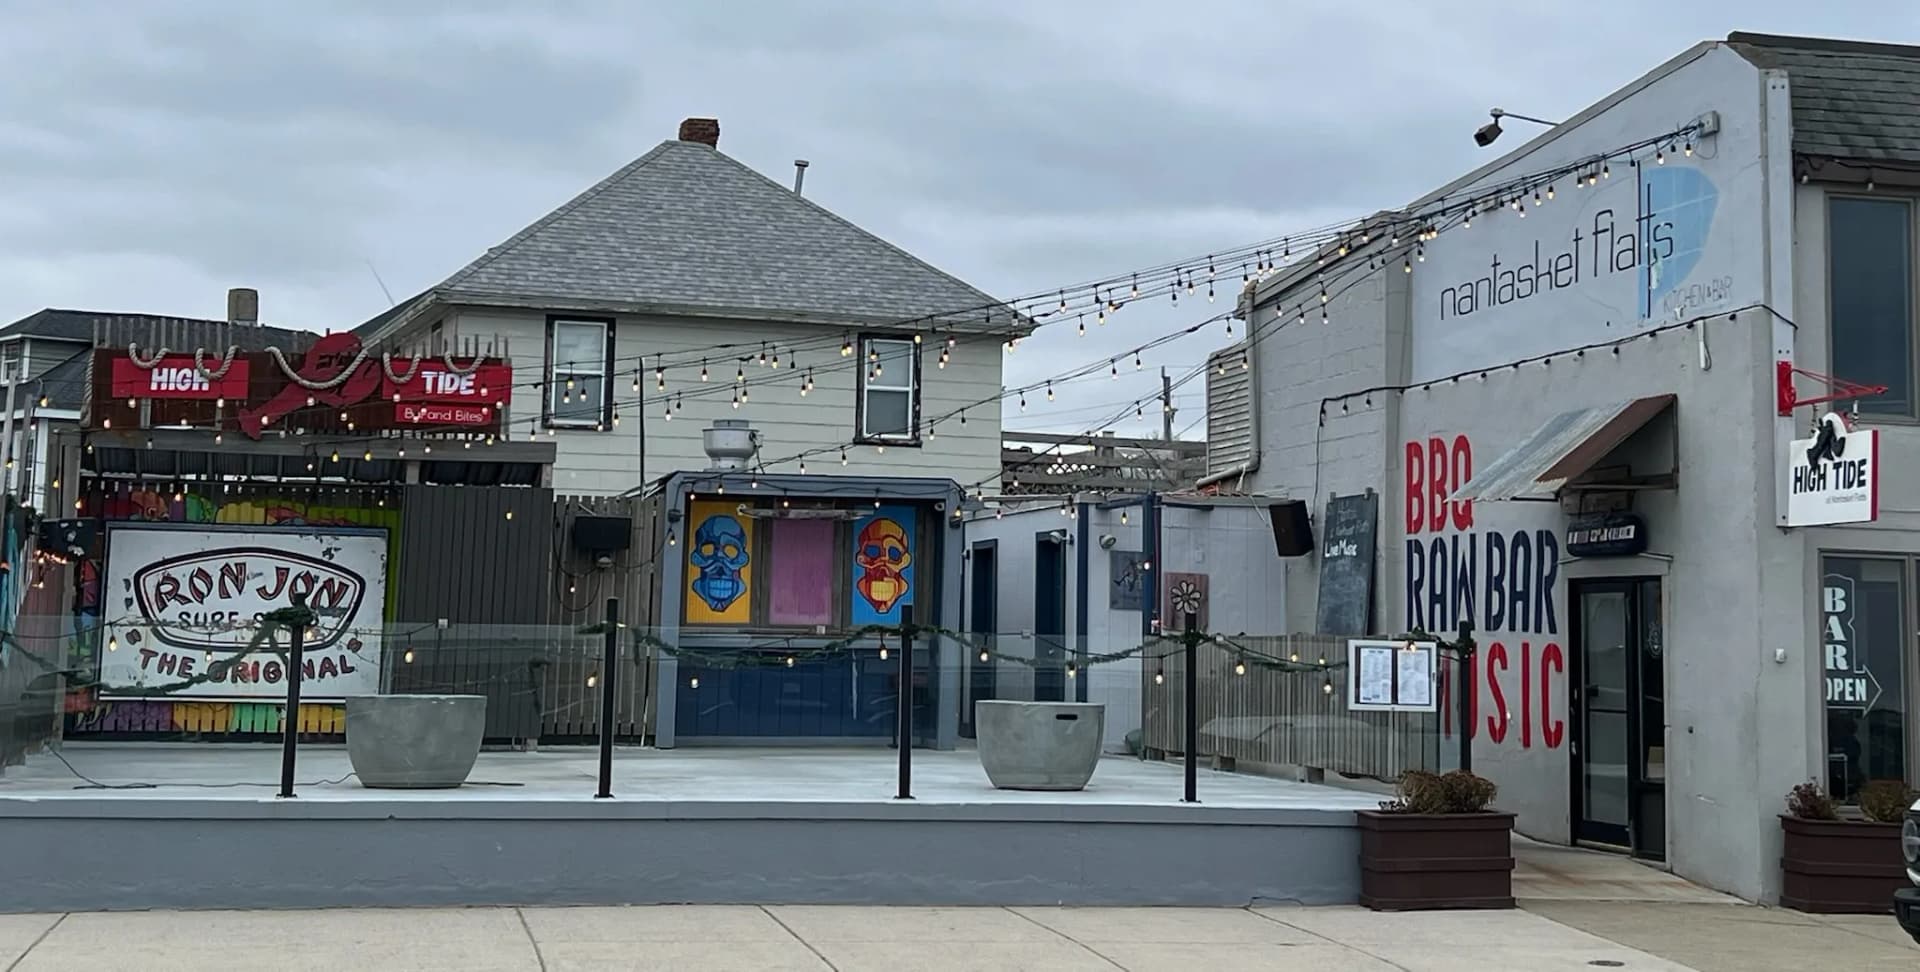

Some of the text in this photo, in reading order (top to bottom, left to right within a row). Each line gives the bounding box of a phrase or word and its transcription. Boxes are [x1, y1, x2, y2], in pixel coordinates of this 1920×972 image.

[1440, 160, 1673, 321] nantasket flatts
[150, 367, 476, 395] HIGH TIDE
[427, 410, 452, 421] and
[455, 410, 484, 423] Bites
[1406, 435, 1474, 534] BBQ
[1794, 459, 1867, 494] HIGH TIDE
[154, 562, 350, 613] RON JON
[1406, 529, 1559, 635] RAW BAR
[178, 611, 240, 629] SURF
[1823, 587, 1849, 670] BAR
[139, 648, 355, 684] THE ORIGNAL
